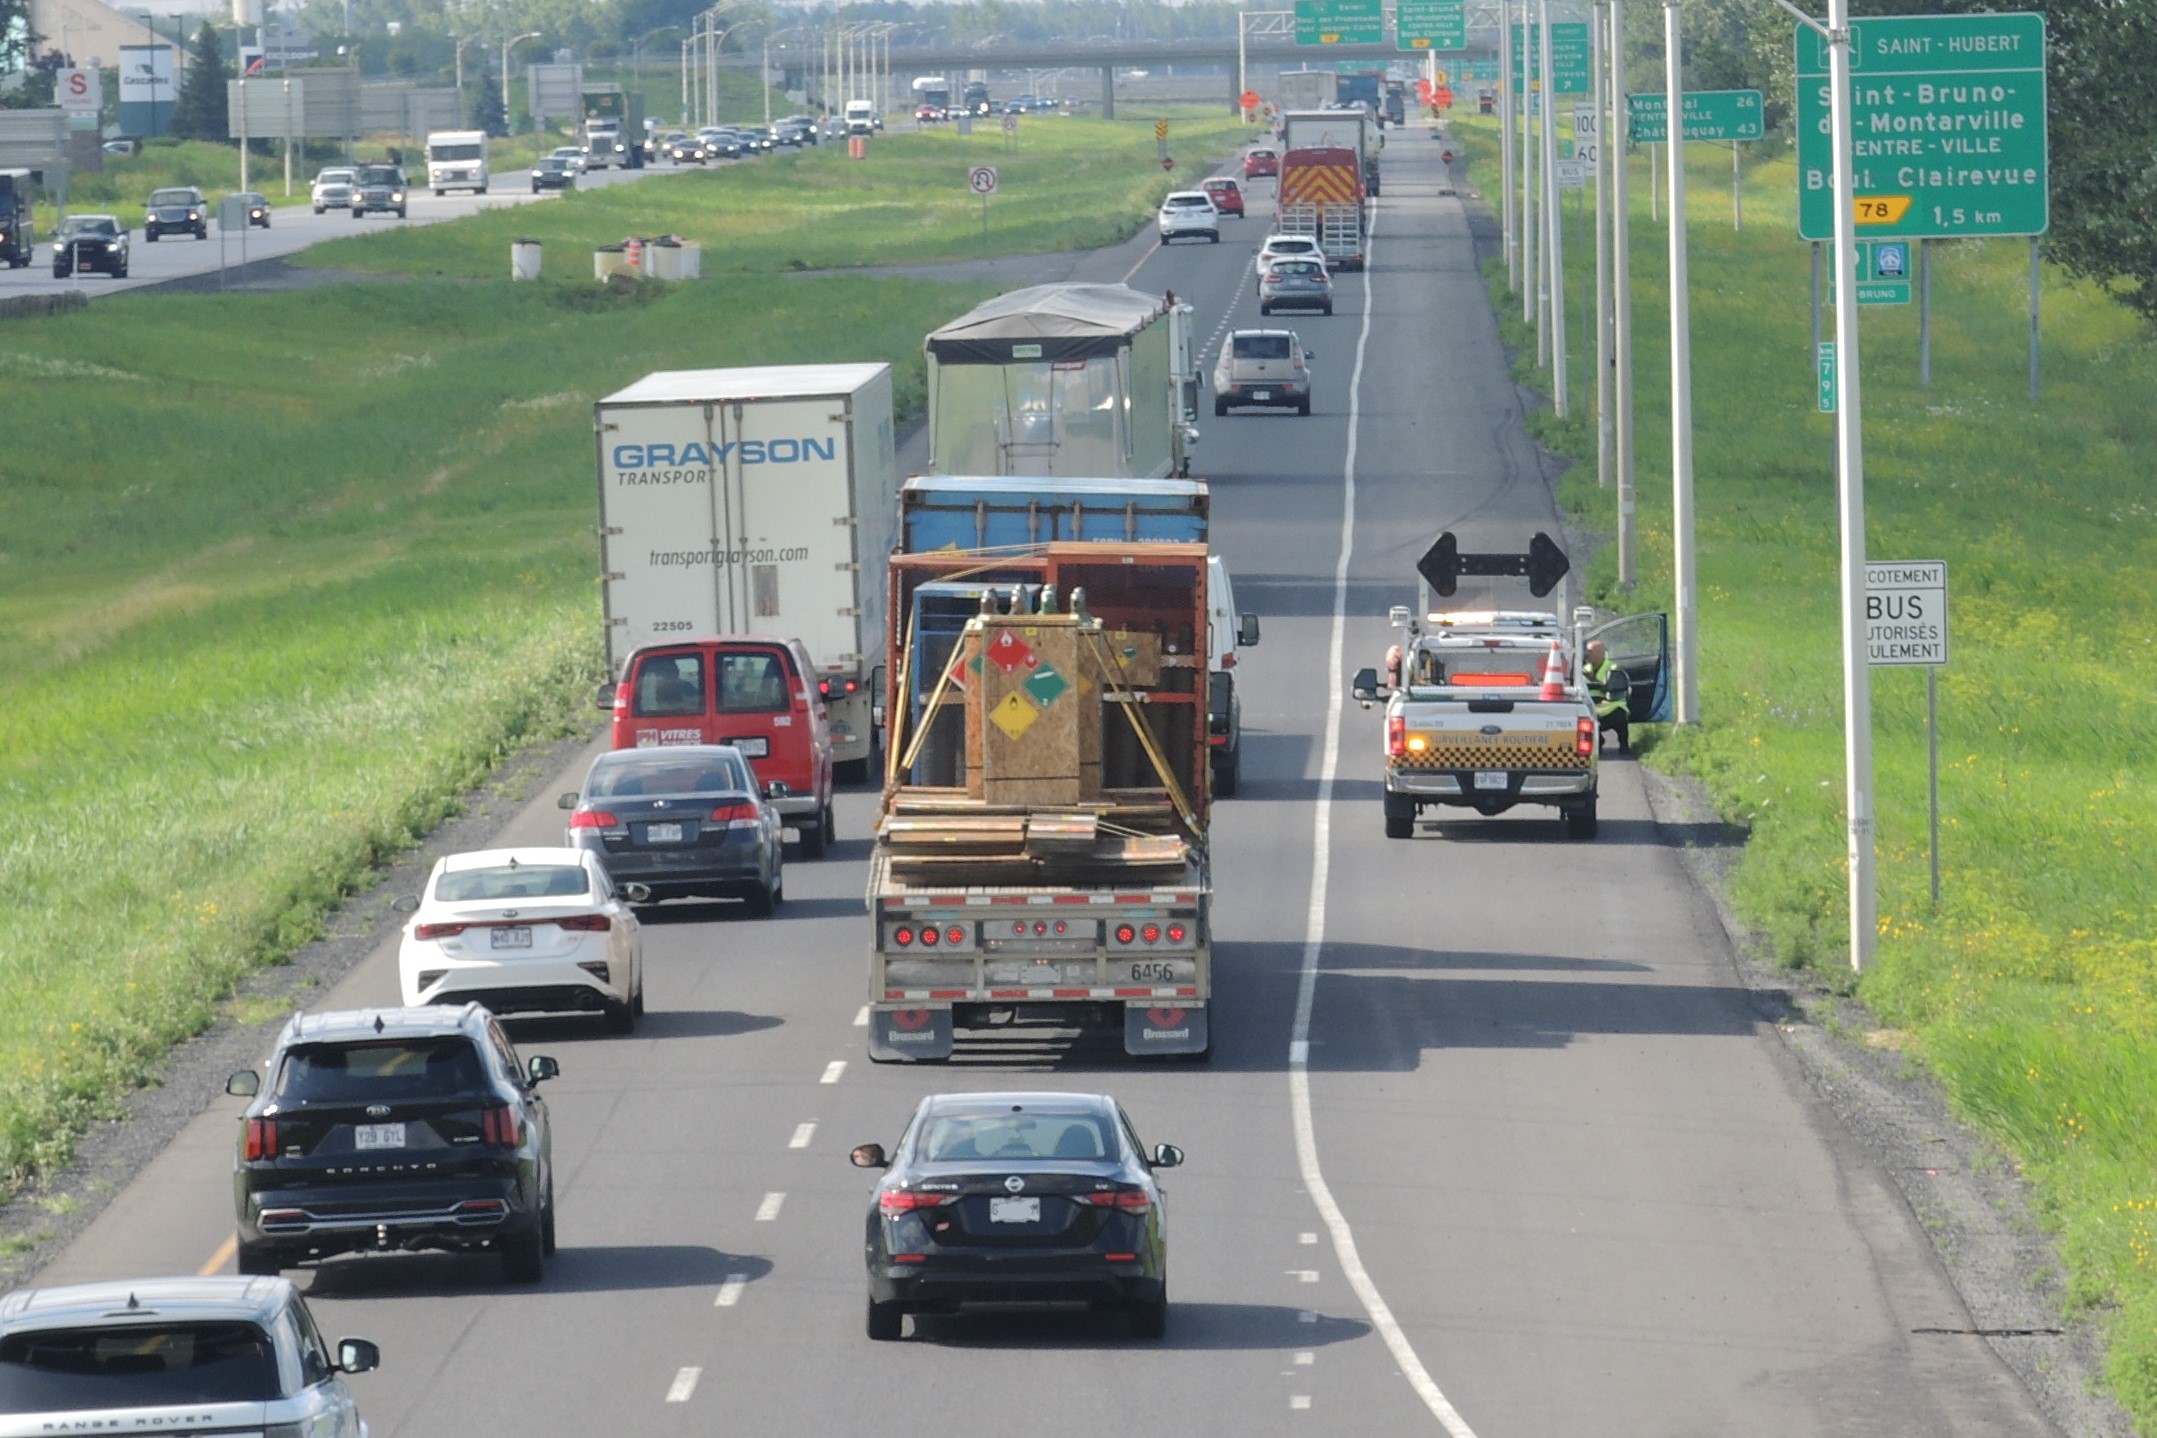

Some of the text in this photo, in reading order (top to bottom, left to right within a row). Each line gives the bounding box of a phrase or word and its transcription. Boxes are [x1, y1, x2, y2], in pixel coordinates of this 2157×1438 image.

[70, 73, 87, 95] S
[1818, 84, 2016, 106] Sint-Bruno-
[1634, 97, 1755, 111] Montal 26
[1737, 123, 1757, 134] 43
[1818, 111, 2025, 134] d-Montarville
[1850, 137, 2002, 157] ENTRE-VILLE
[1898, 166, 2037, 187] Clairevue
[1860, 203, 1888, 218] 78
[1975, 211, 2001, 225] km
[1856, 289, 1896, 299] -BRUNO
[613, 437, 835, 469] GRAYSON
[1865, 569, 1939, 583] COTEMENT
[1867, 595, 1923, 619] BUS
[653, 621, 693, 631] 22505
[1868, 643, 1941, 659] ULEMENT
[660, 728, 701, 739] VITRES
[1131, 963, 1174, 981] 6456
[43, 1415, 213, 1430] RANGE ROVER
